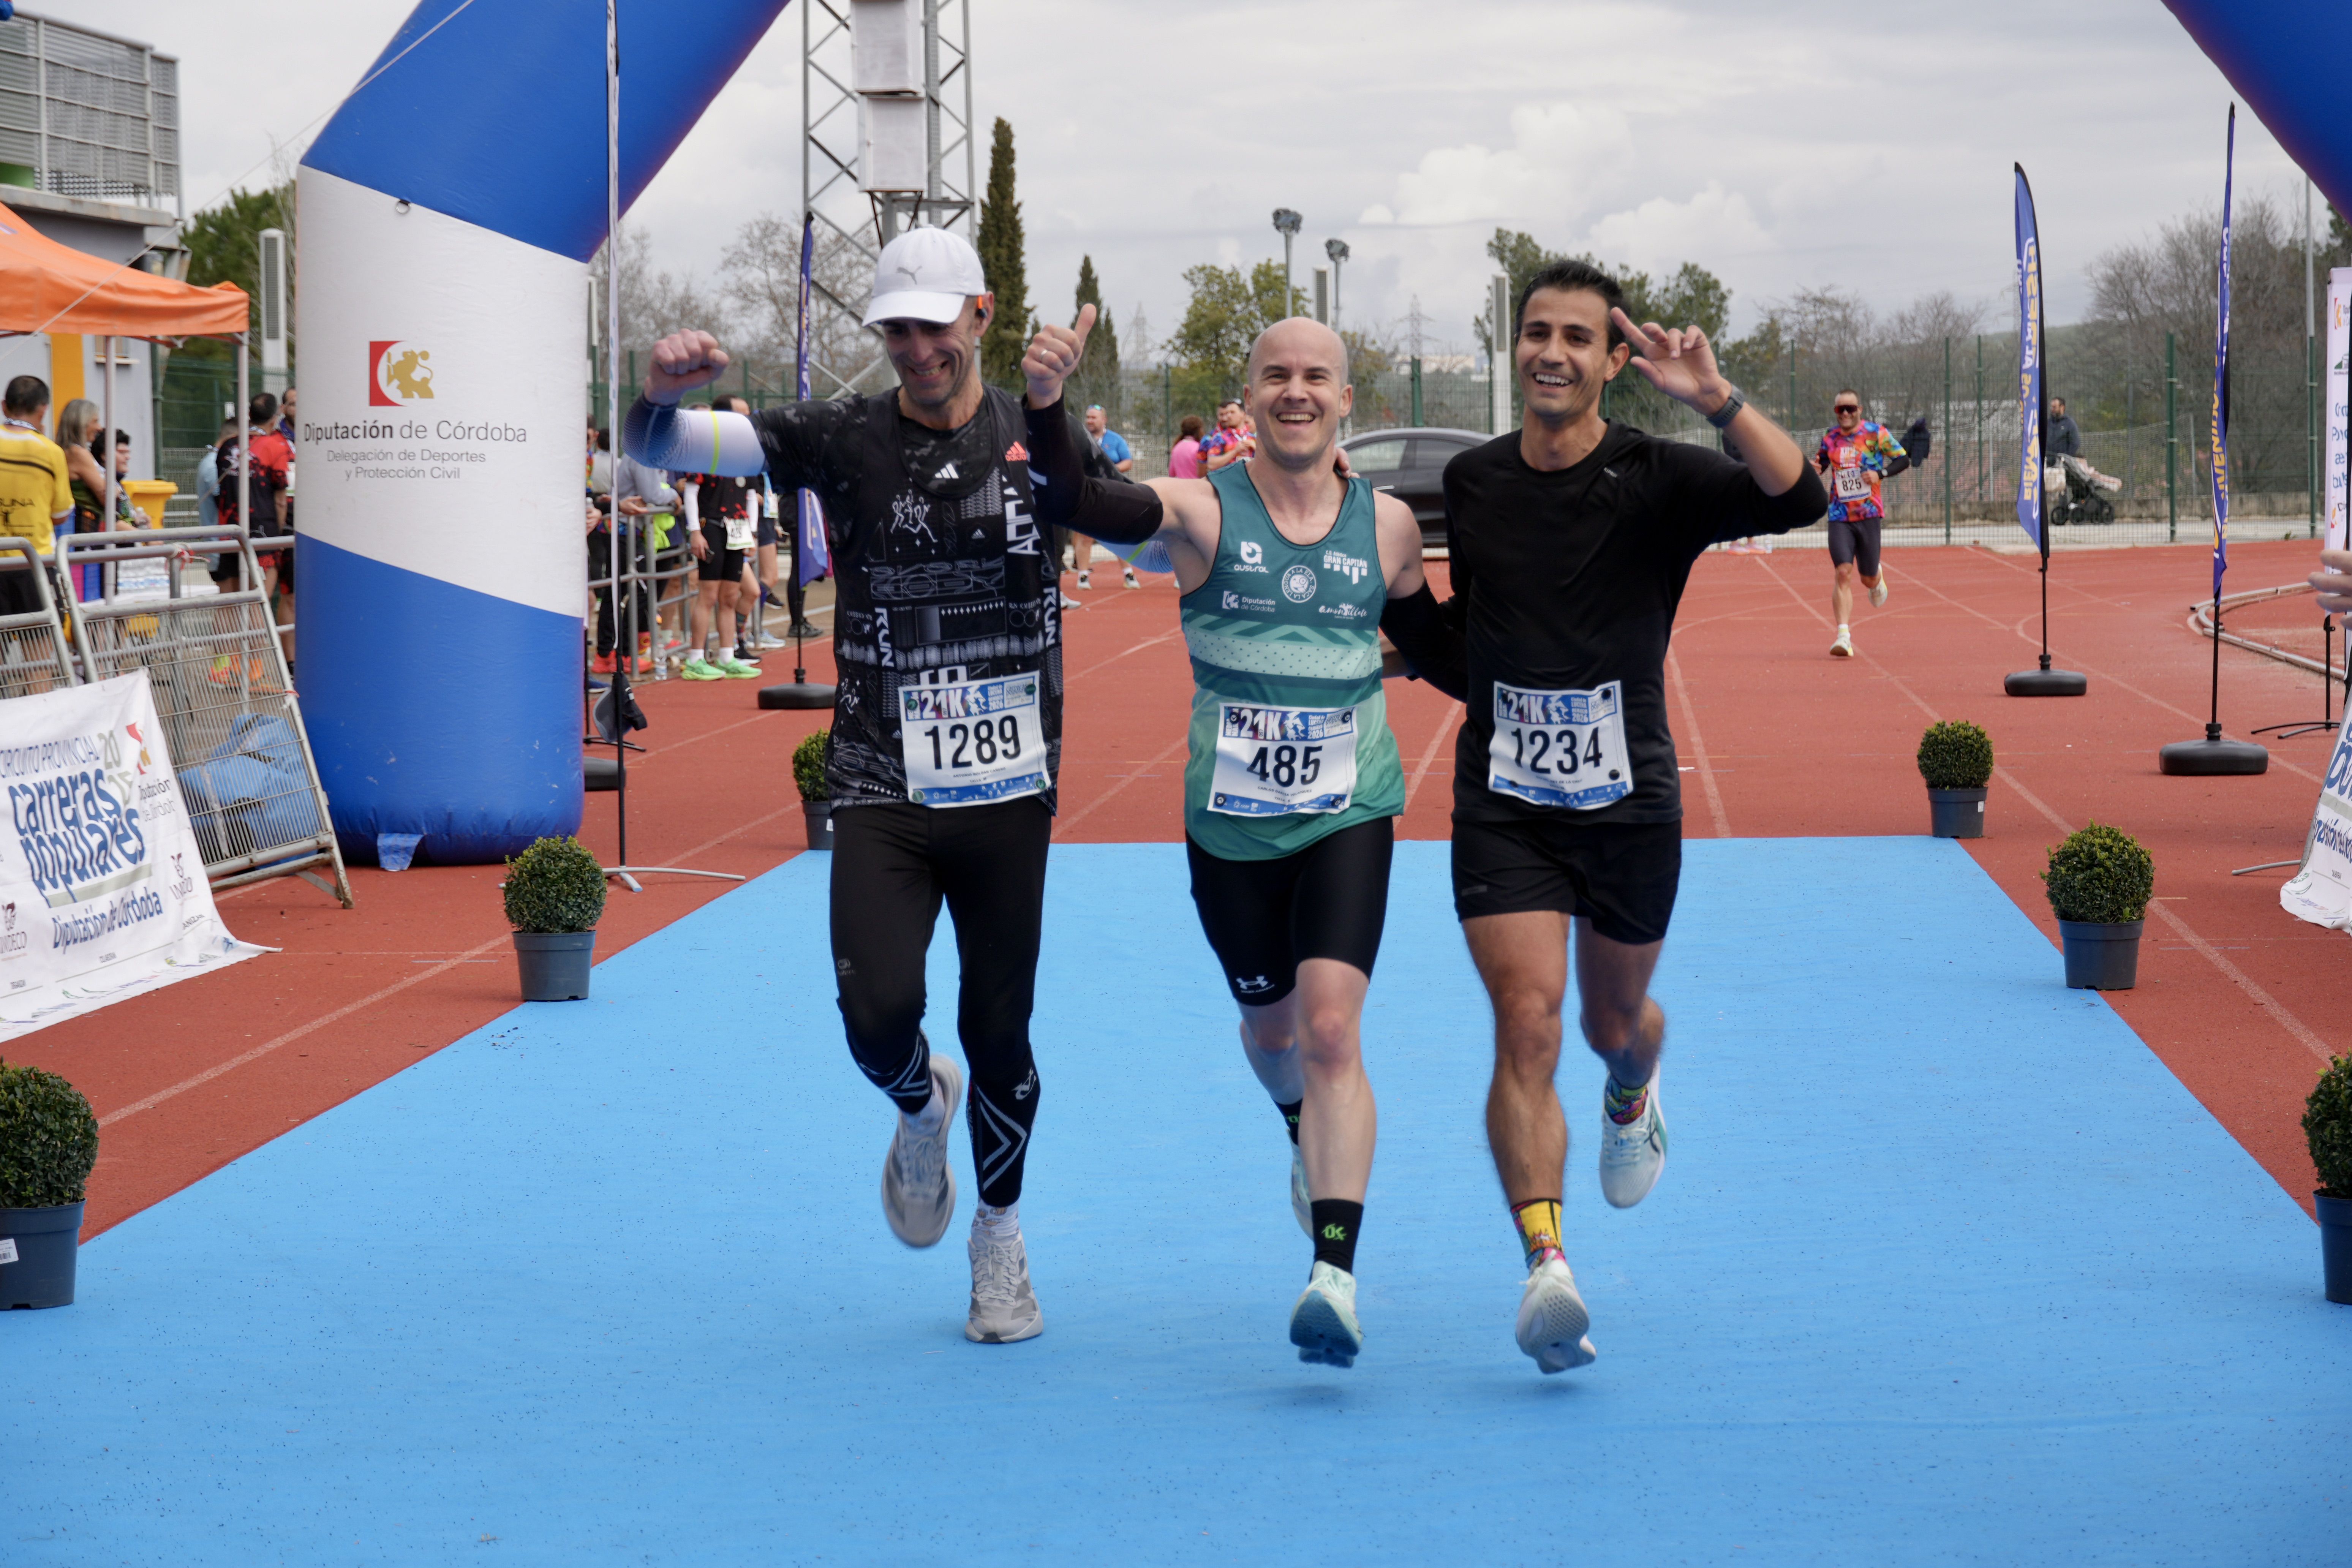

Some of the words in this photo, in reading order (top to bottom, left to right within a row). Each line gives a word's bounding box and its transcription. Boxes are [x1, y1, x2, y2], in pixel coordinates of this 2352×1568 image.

[305, 420, 393, 445] Diputación
[400, 420, 428, 439] de
[437, 420, 527, 442] Córdoba
[327, 449, 394, 464] Delegación
[398, 449, 416, 461] de
[421, 449, 486, 463] Deportes
[1005, 453, 1027, 462] adidas
[345, 469, 352, 481] y
[355, 467, 425, 479] Protección
[430, 467, 460, 479] Civil
[1842, 479, 1862, 491] 825
[1234, 564, 1269, 573] austral
[1324, 555, 1341, 565] GRAN
[1342, 558, 1367, 568] CAPITÁN
[1284, 573, 1293, 596] LENGUA
[1304, 569, 1314, 582] ELA
[1242, 596, 1276, 605] Diputación
[1043, 586, 1057, 647] RUN
[874, 607, 894, 667] RUN
[920, 688, 966, 720] 21K
[1507, 692, 1546, 724] 21K
[1240, 709, 1282, 740] 21K
[1307, 729, 1323, 740] 2026
[97, 730, 122, 770] 20
[925, 714, 1021, 770] 1289
[1511, 726, 1603, 775] 1234
[1246, 745, 1323, 788] 485
[8, 768, 122, 839] carreras
[20, 808, 145, 908] populares
[118, 887, 163, 928] Córdoba
